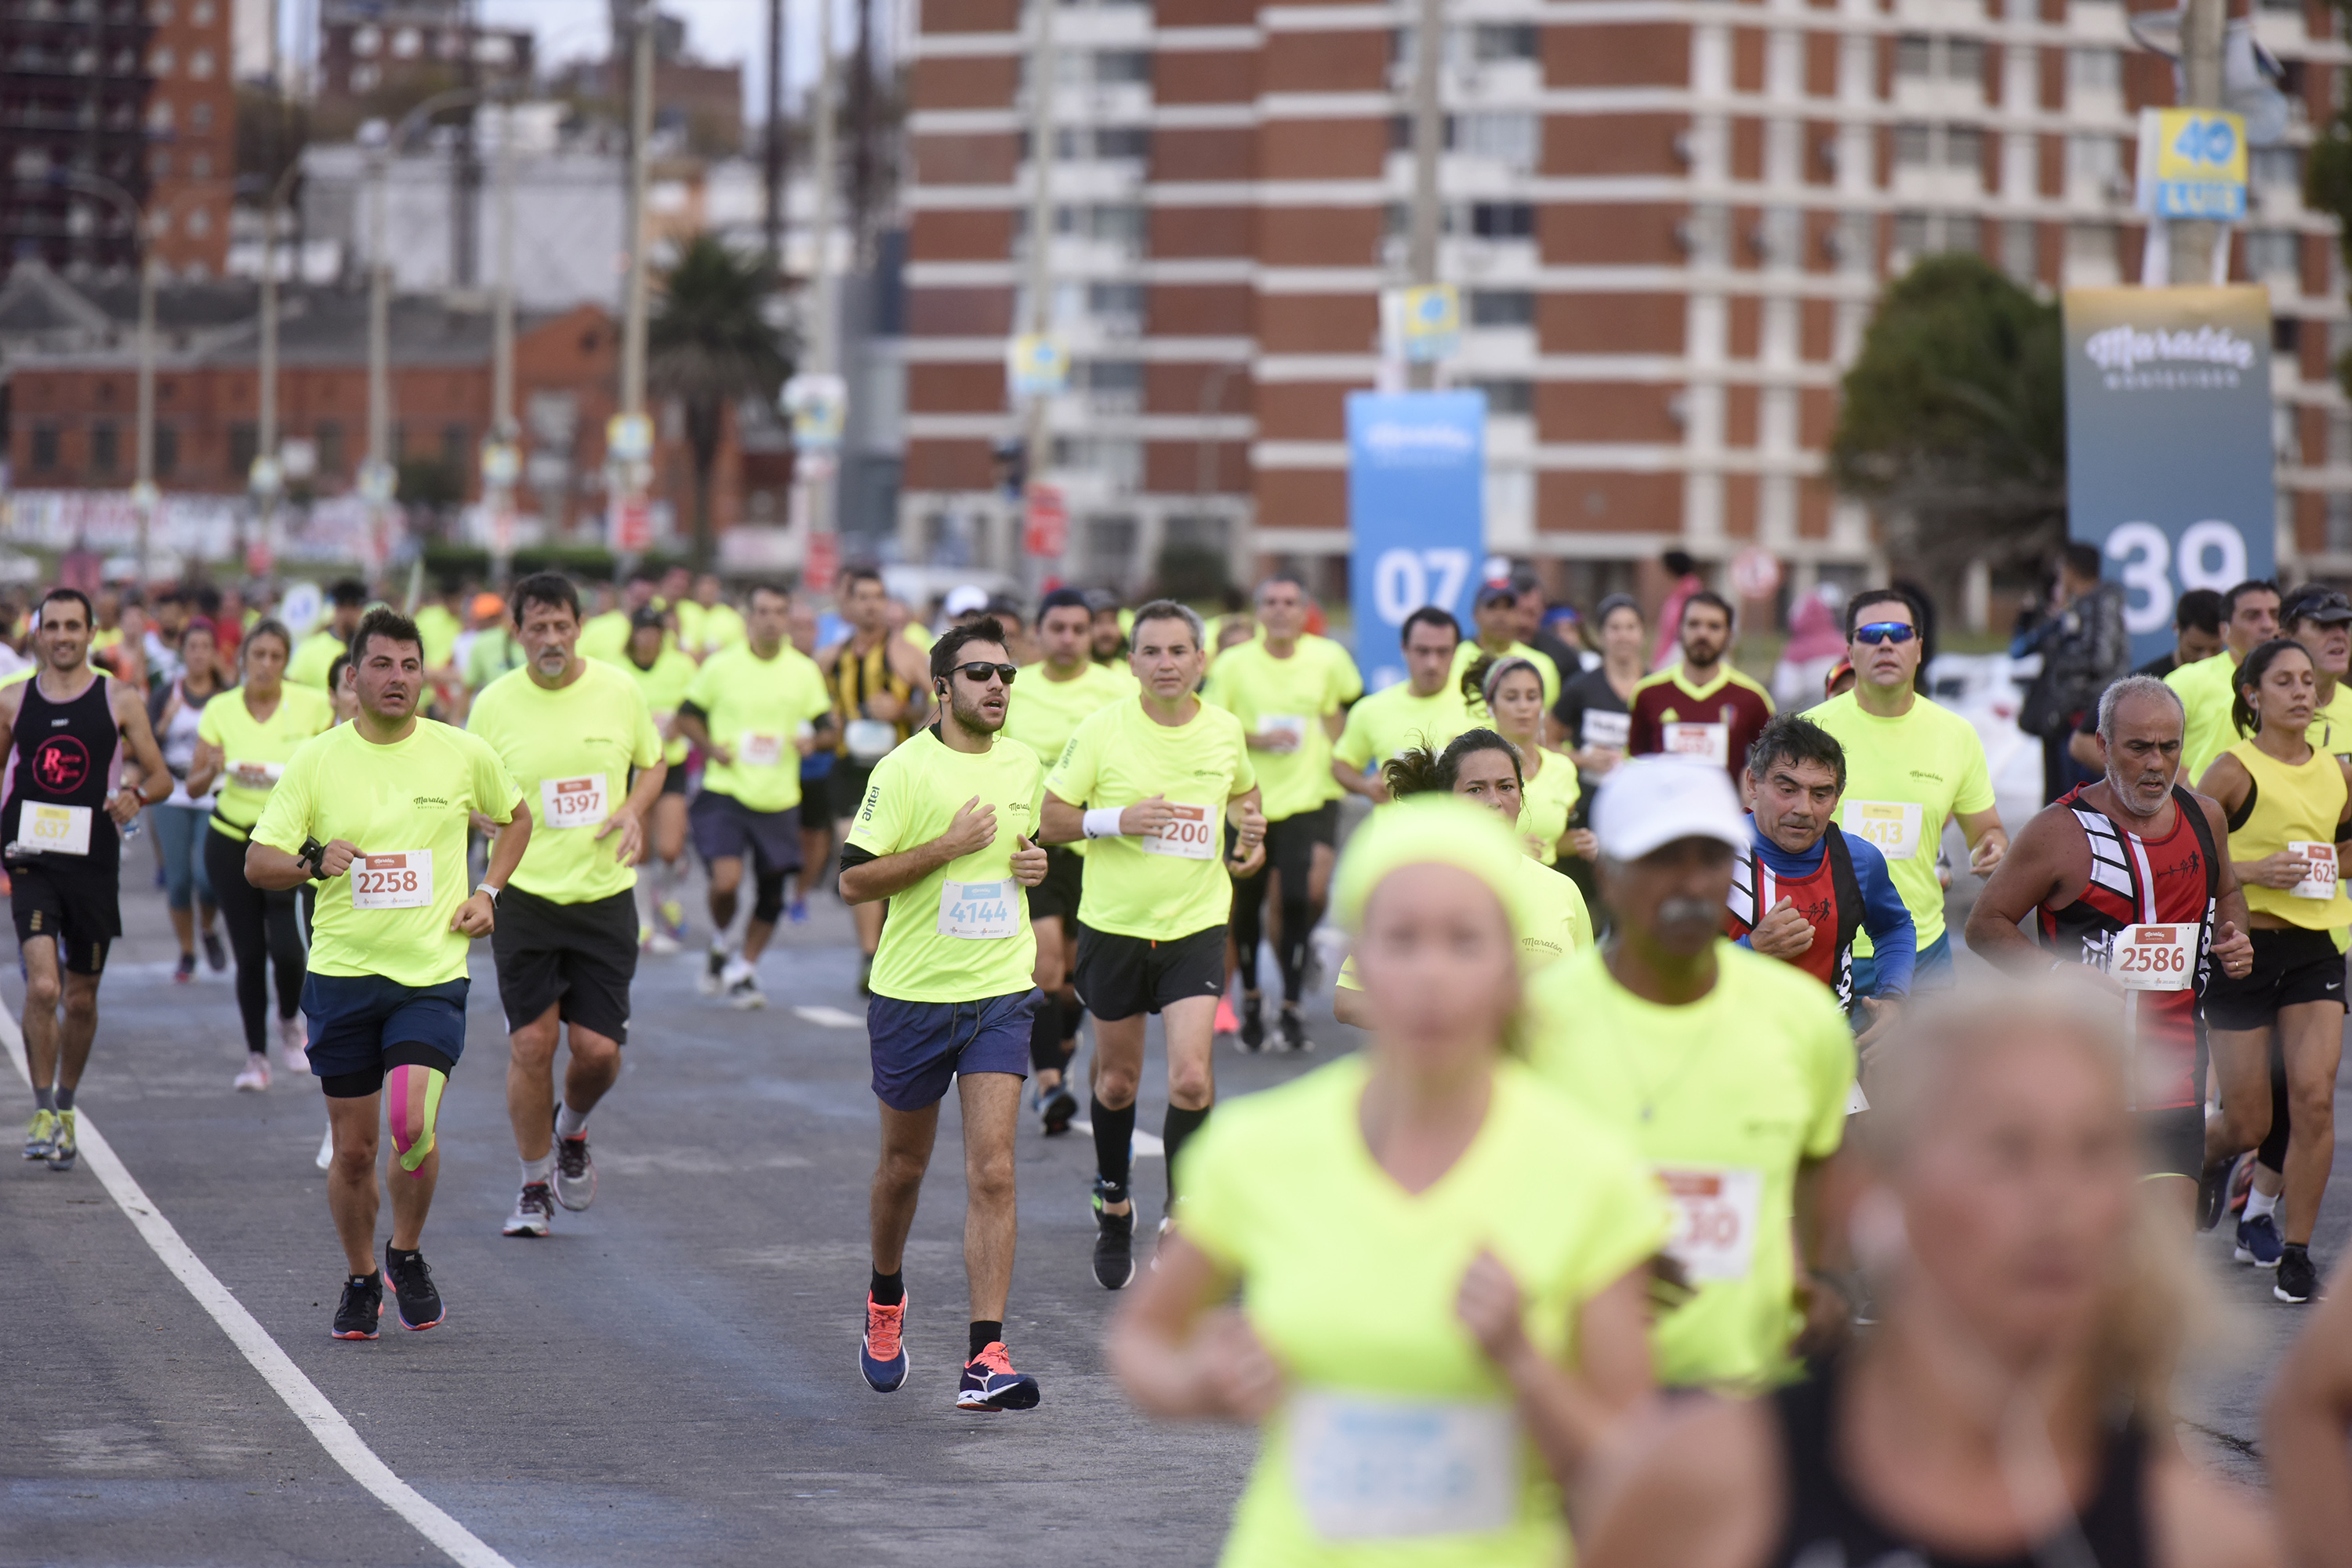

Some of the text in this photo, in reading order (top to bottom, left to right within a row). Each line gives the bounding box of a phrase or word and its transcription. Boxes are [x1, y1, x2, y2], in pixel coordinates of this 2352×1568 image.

[2174, 118, 2235, 165] 40
[1373, 547, 1472, 626] 07
[2105, 520, 2249, 634] 39
[413, 797, 448, 805] Maratón
[553, 792, 600, 814] 1397
[862, 786, 880, 822] antel
[34, 821, 71, 840] 637
[1158, 822, 1209, 844] 200
[1860, 820, 1904, 844] 413
[358, 870, 418, 894] 2258
[2303, 862, 2336, 884] 625
[949, 900, 1008, 924] 4144
[1522, 937, 1563, 953] Maratón
[2119, 947, 2185, 972] 2586
